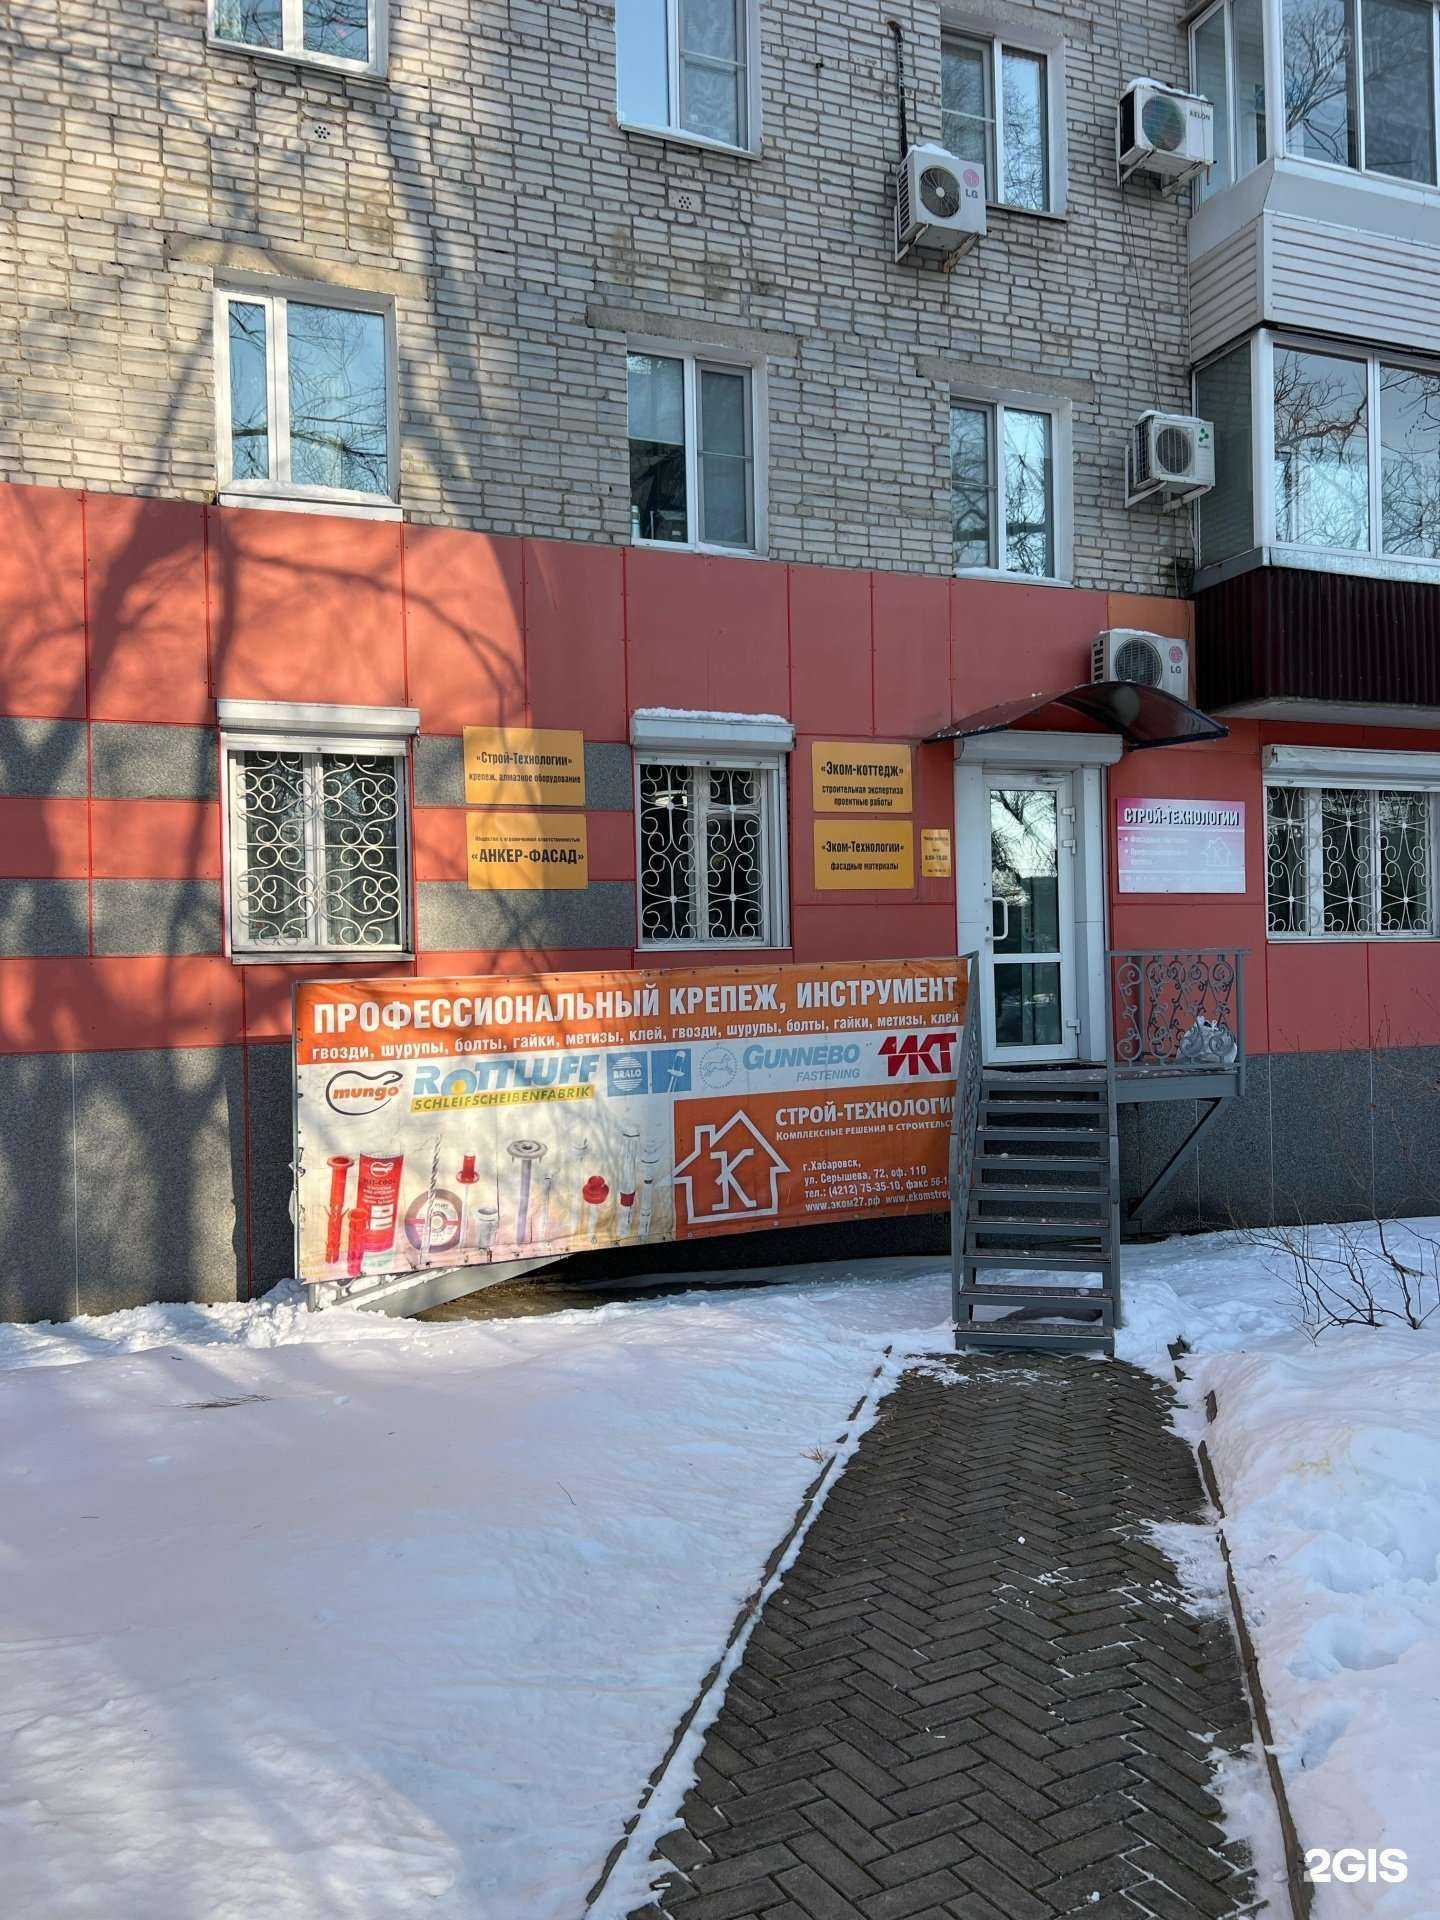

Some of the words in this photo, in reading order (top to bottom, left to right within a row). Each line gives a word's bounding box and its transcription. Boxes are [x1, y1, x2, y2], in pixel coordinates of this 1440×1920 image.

[965, 188, 978, 199] LG
[1170, 664, 1182, 674] LG
[476, 751, 573, 767] «Строй-Технологии»
[820, 760, 904, 778] «Эком-коттедж»
[534, 774, 581, 784] оборудование
[822, 784, 867, 794] строительная
[868, 785, 904, 795] экспертиза
[834, 798, 868, 807] проектные
[869, 798, 893, 807] работы
[1123, 807, 1240, 827] СТРОЙ-ТЕХНОЛОГИИ
[821, 841, 904, 853] «Эком-Технологии»
[471, 848, 584, 865] «АНКЕР-ФАСАД»
[830, 862, 863, 872] фасадные
[864, 862, 899, 871] материалы
[313, 983, 659, 1034] ПРОФЕССИОНАЛЬНЫЙ
[669, 983, 787, 1015] КРЕПЕЖ,
[797, 976, 958, 1009] ИНСТРУМЕНТ
[312, 1045, 374, 1061] гвозди,
[381, 1041, 448, 1060] шурупы,
[454, 1038, 507, 1053] болты,
[513, 1034, 559, 1050] гайки,
[566, 1031, 624, 1046] метизы,
[629, 1028, 666, 1042] клей,
[672, 1025, 722, 1040] гвозди,
[726, 1022, 781, 1038] шурупы,
[786, 1018, 829, 1033] болты,
[834, 1015, 873, 1031] гайки,
[877, 1014, 926, 1028] метизы,
[931, 1011, 959, 1025] клей
[743, 1043, 860, 1071] GUNNEBO
[613, 1068, 642, 1080] BRALO
[796, 1067, 860, 1083] FASTENING
[332, 1085, 400, 1102] mungo
[414, 1085, 592, 1111] SCHLEIFSCHEIBENFABRIK
[802, 1158, 862, 1172] г.Хабаровск,
[804, 1175, 818, 1187] ул.
[820, 1171, 871, 1185] Серышева,
[873, 1168, 889, 1180] 72,
[891, 1167, 908, 1180] оф.
[910, 1165, 927, 1176] 110
[804, 1188, 827, 1198] тел.:
[828, 1184, 858, 1197] (4212)
[860, 1181, 904, 1194] 75-35-10,
[906, 1178, 929, 1190] факс
[805, 1195, 881, 1212] www.эком27.рф
